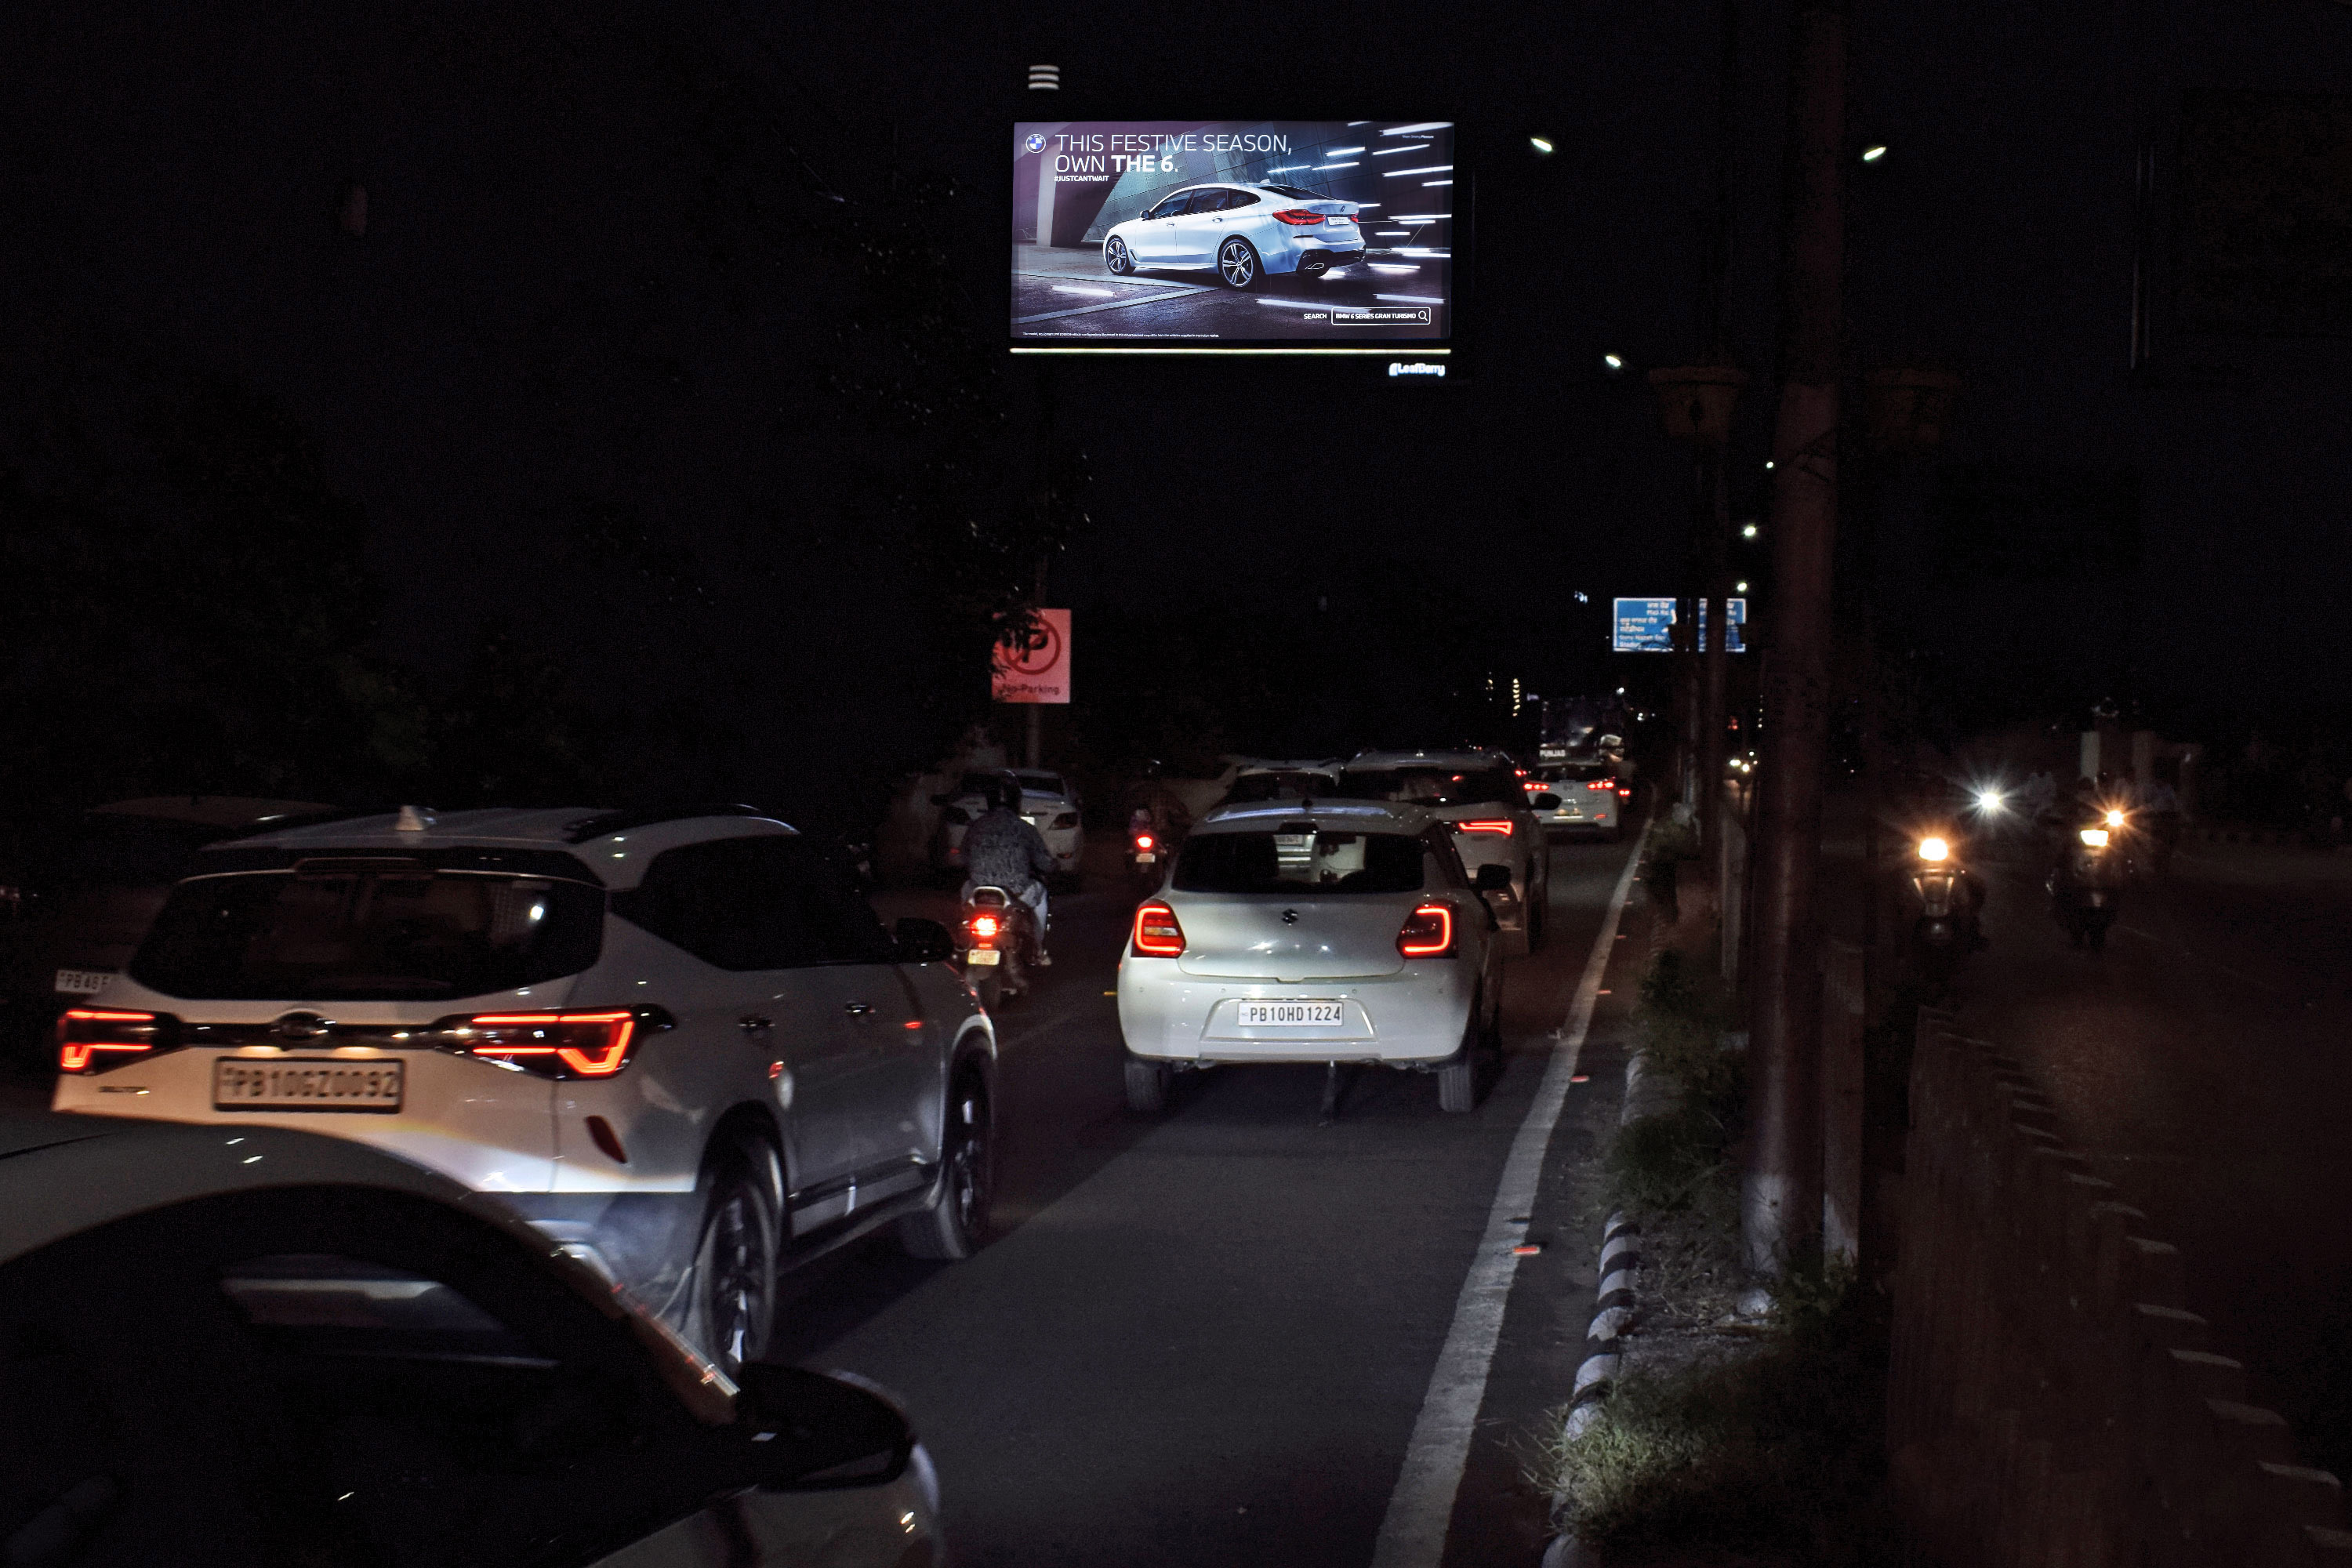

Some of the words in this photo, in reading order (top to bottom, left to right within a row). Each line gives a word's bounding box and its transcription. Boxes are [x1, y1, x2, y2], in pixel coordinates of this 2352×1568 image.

[1054, 134, 1105, 152] THIS
[1111, 134, 1197, 152] FESTIVE
[1203, 134, 1292, 155] SEASON,
[1054, 154, 1105, 172] OWN
[1110, 154, 1156, 172] THE
[1160, 154, 1178, 172] 6.
[1250, 1006, 1341, 1022] PB10HD1224
